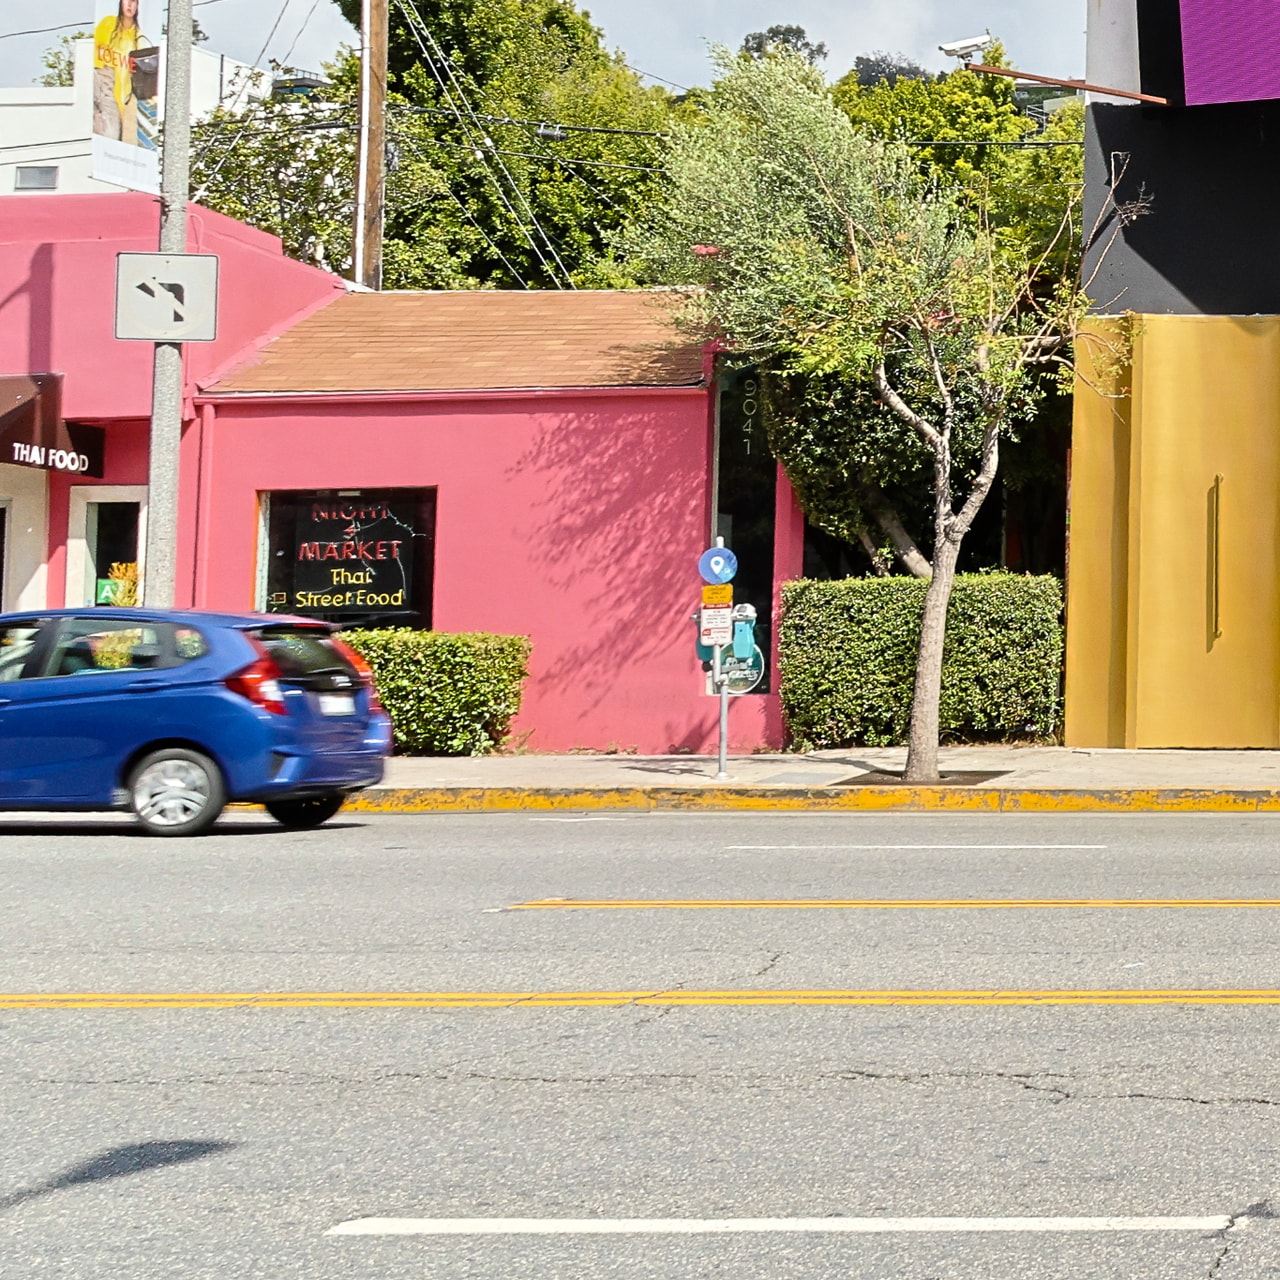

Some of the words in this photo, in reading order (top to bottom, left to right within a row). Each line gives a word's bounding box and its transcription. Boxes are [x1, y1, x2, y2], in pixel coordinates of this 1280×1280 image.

[97, 45, 137, 73] LOEWE
[742, 379, 758, 456] 9041
[12, 442, 46, 465] THAI
[47, 448, 89, 472] FOOD
[298, 540, 403, 561] MARKET
[330, 567, 372, 586] Thai
[100, 584, 114, 600] A
[295, 591, 352, 608] Street
[356, 588, 404, 607] Food
